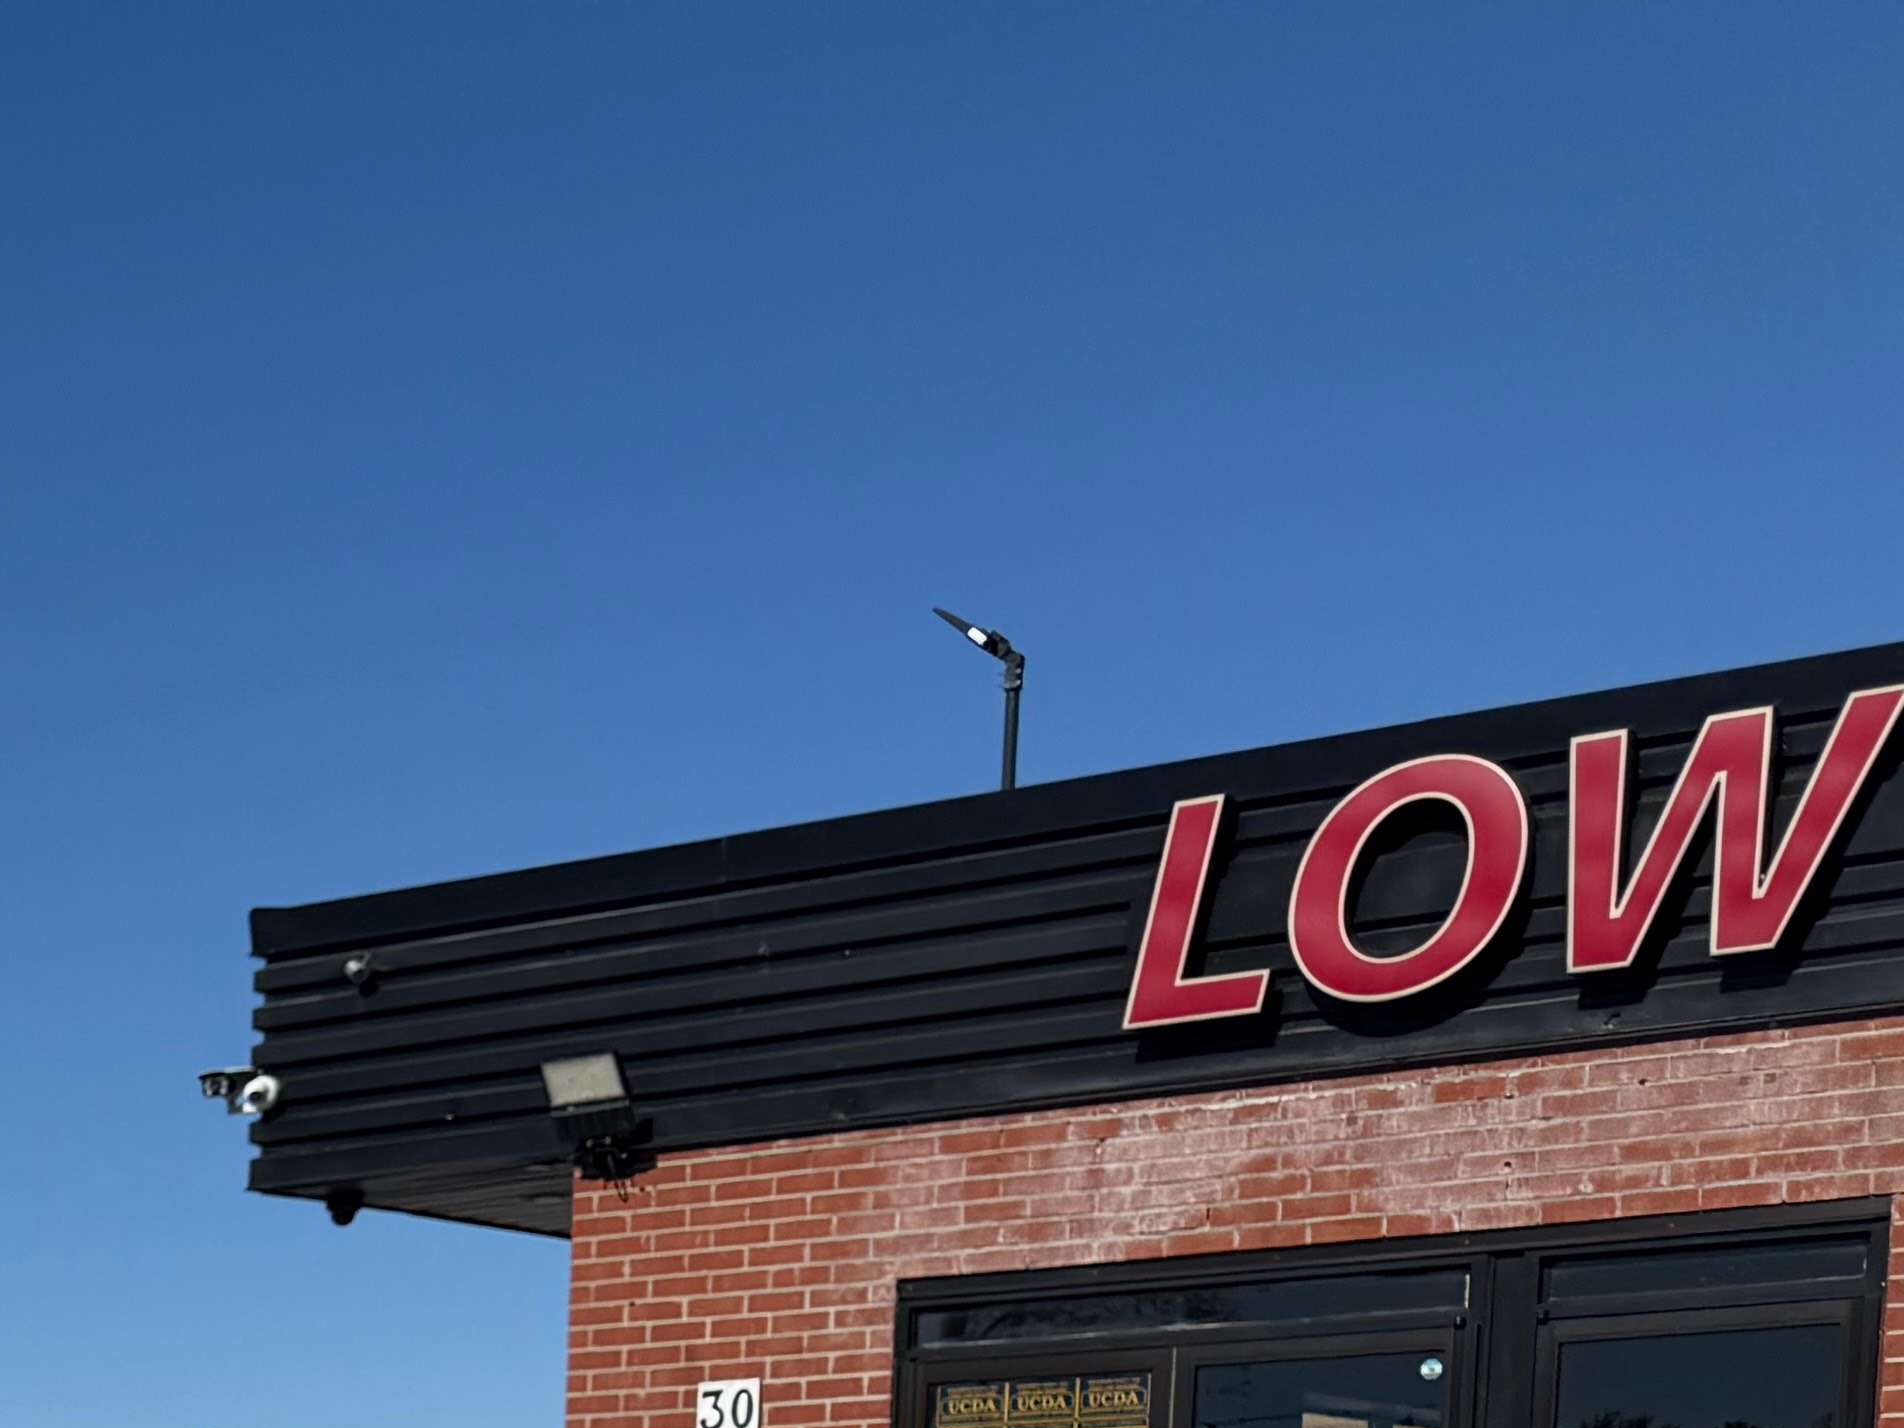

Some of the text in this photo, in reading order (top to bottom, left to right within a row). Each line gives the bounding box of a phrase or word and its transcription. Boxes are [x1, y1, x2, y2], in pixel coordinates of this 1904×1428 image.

[1123, 683, 1904, 1030] LOW
[1017, 1395, 1068, 1411] UCDA
[1088, 1391, 1140, 1407] UCDA
[948, 1400, 998, 1415] UCDA
